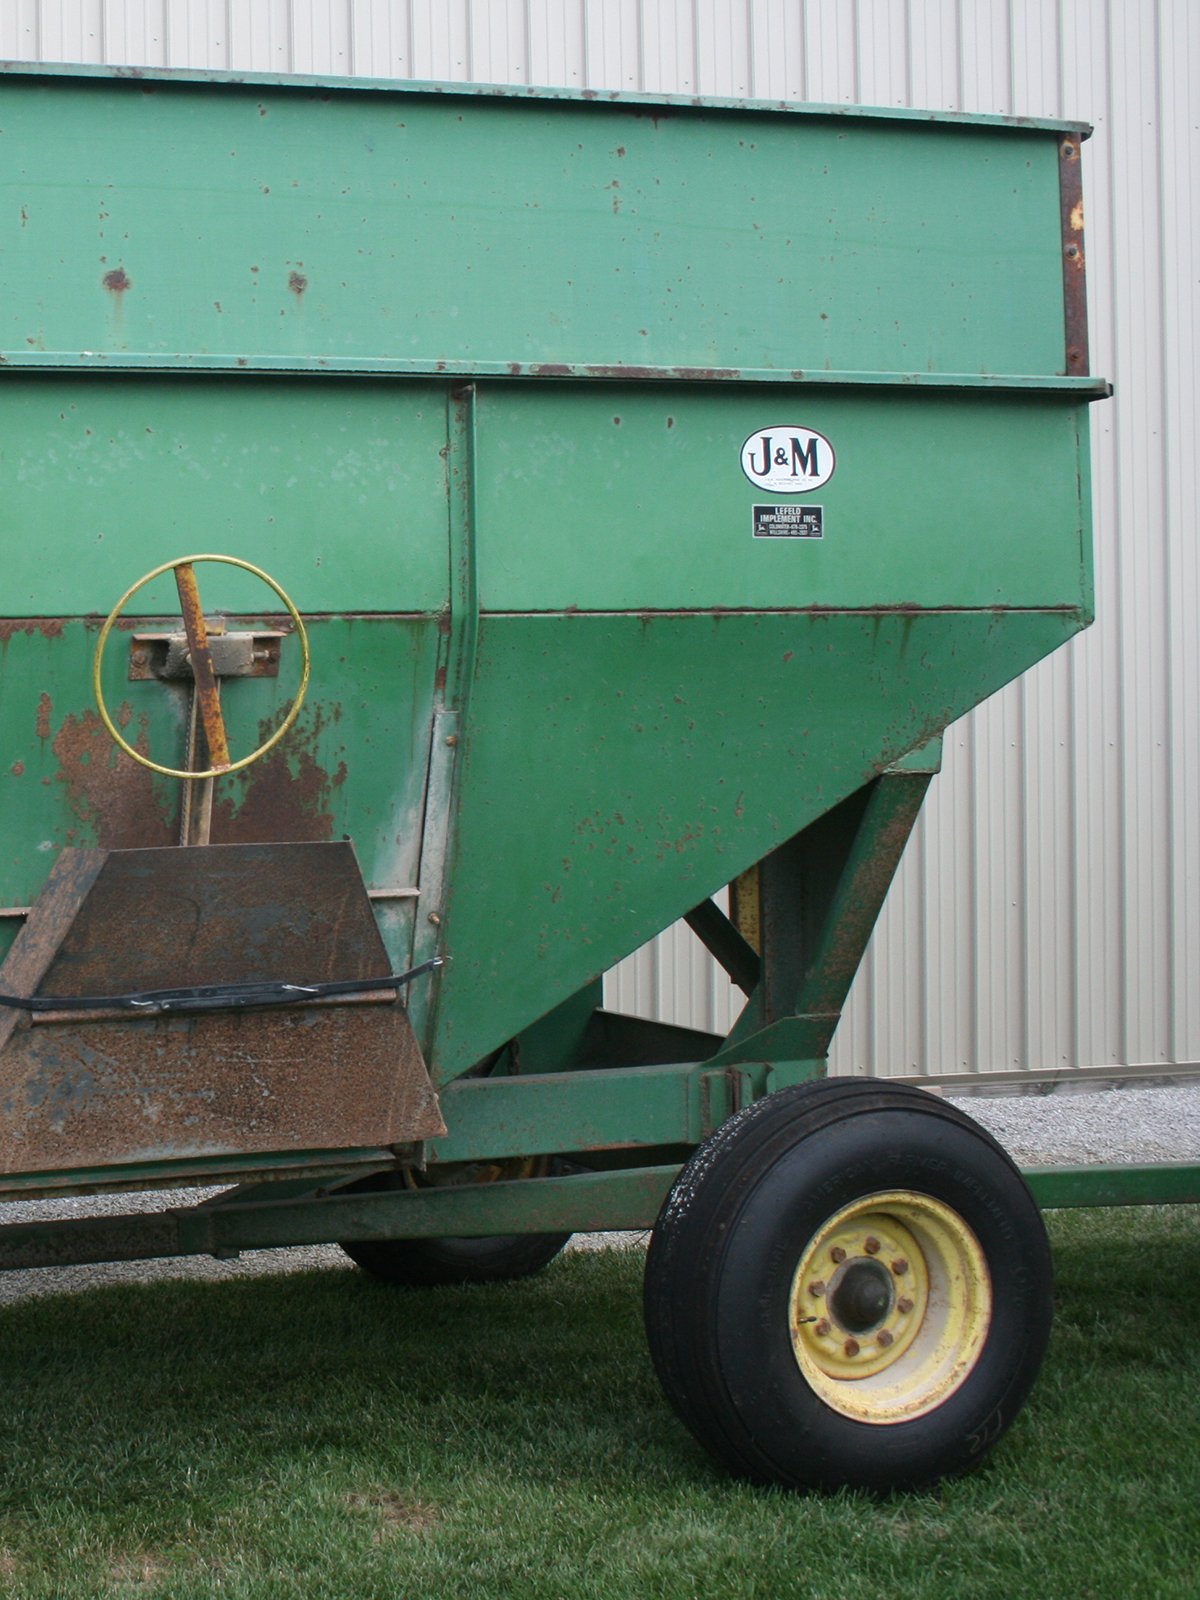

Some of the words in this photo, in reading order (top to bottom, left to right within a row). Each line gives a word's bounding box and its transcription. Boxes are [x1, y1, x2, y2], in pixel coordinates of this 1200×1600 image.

[747, 436, 820, 477] J&M
[760, 515, 801, 523] IMPLEMENT
[803, 515, 818, 523] INC.
